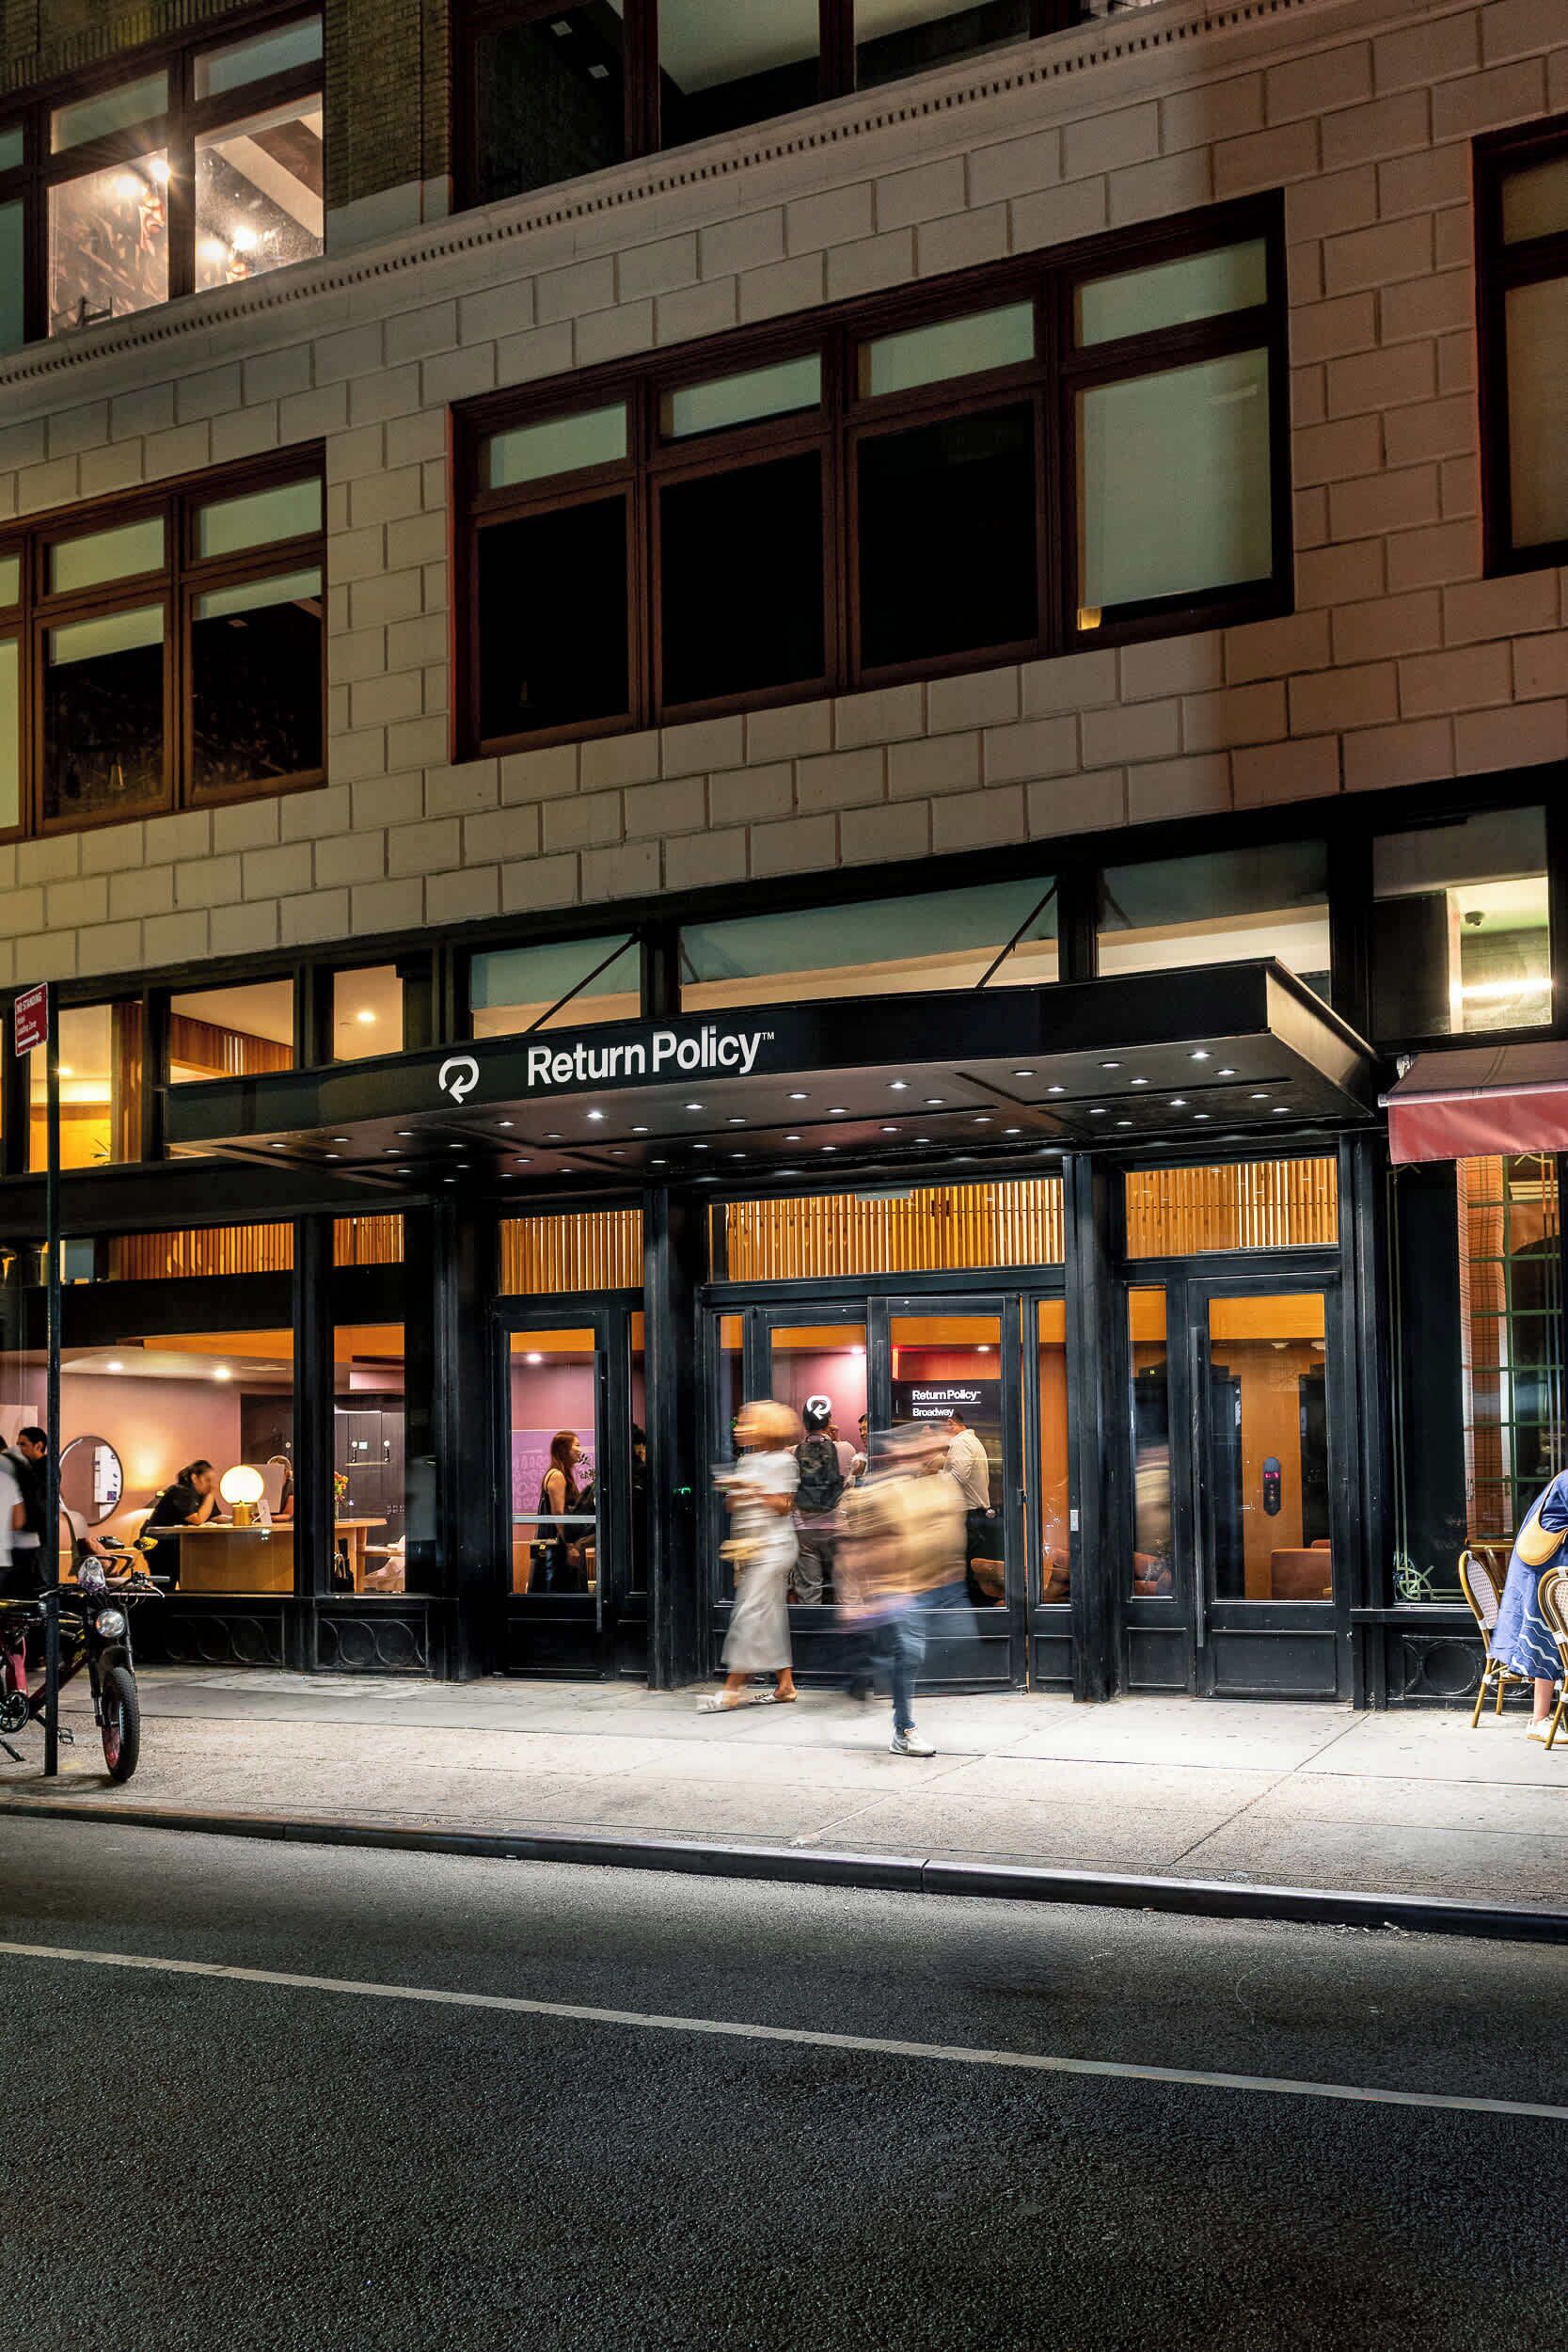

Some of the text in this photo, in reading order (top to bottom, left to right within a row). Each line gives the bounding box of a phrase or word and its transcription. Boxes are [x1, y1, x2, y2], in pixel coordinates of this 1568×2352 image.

[526, 1042, 647, 1087] Return
[911, 1390, 946, 1402] Return
[912, 1406, 955, 1418] Broadway
